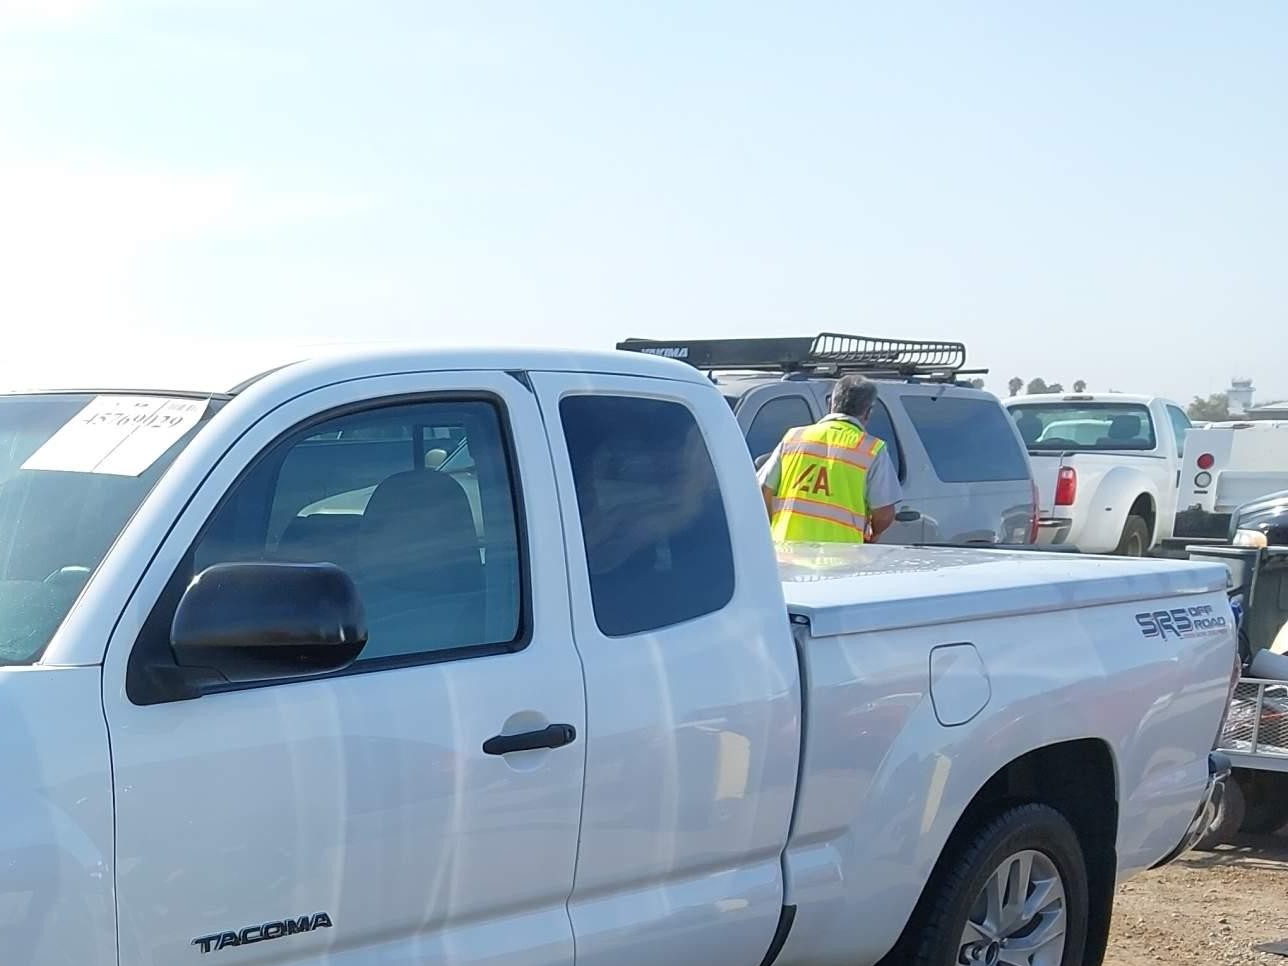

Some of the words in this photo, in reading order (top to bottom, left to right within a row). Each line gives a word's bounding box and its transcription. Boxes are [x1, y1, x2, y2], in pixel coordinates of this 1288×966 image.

[1135, 608, 1194, 642] SR5
[1194, 617, 1226, 631] ROAD
[191, 911, 334, 954] TACOMA
